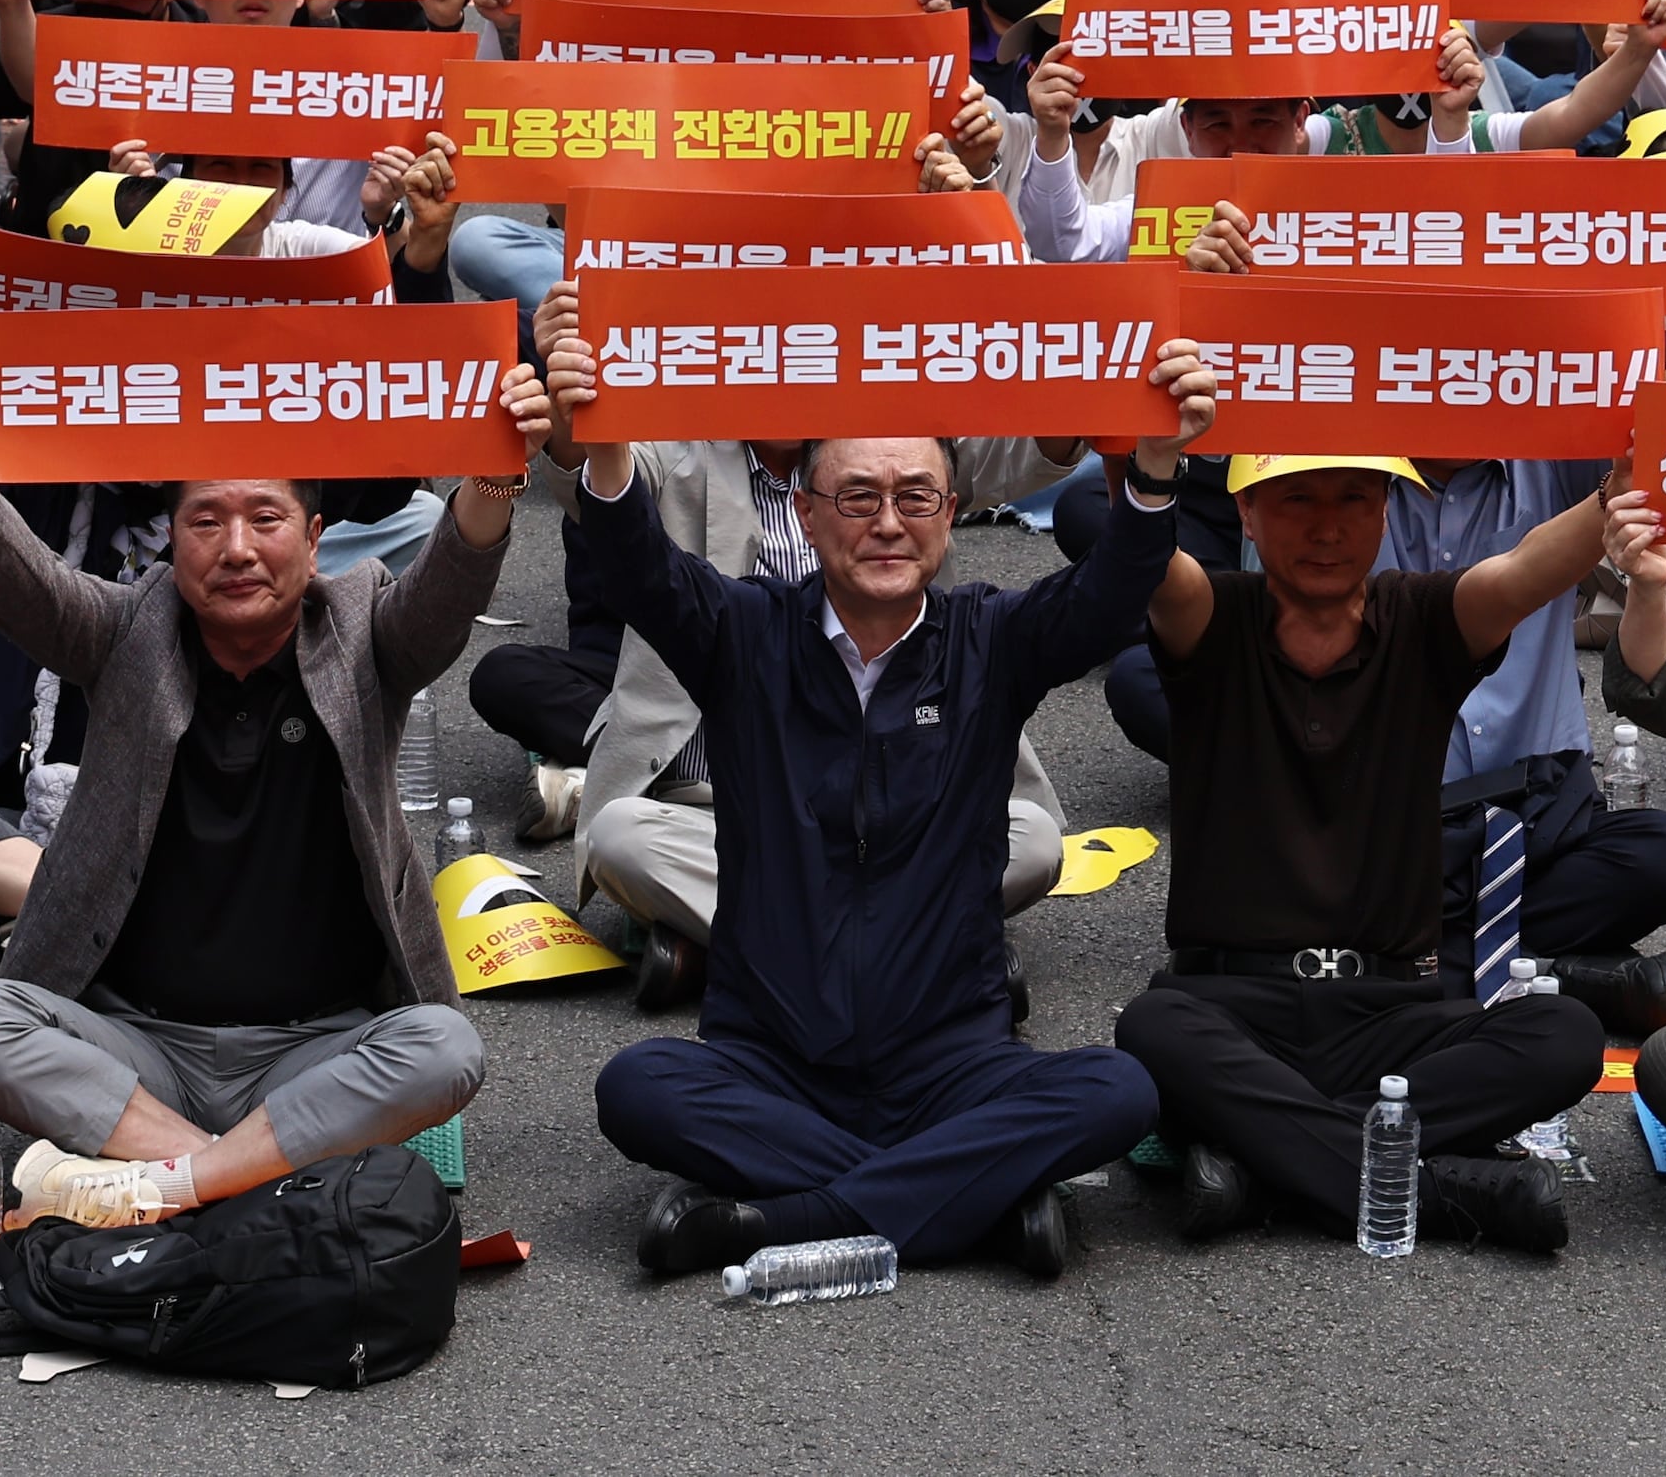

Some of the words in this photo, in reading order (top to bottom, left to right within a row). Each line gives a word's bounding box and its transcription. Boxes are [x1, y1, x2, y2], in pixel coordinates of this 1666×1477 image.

[462, 108, 656, 160] 고용정책
[673, 109, 911, 159] 전환하라!!
[159, 232, 180, 251] 더
[1245, 211, 1464, 266] 생존권을
[599, 323, 839, 387] 생존권을
[860, 321, 1158, 383] 보장하라!!
[203, 360, 500, 422] 보장하라!!
[464, 942, 488, 964] 더
[486, 916, 544, 948] 이상은
[477, 934, 551, 978] 생존권을
